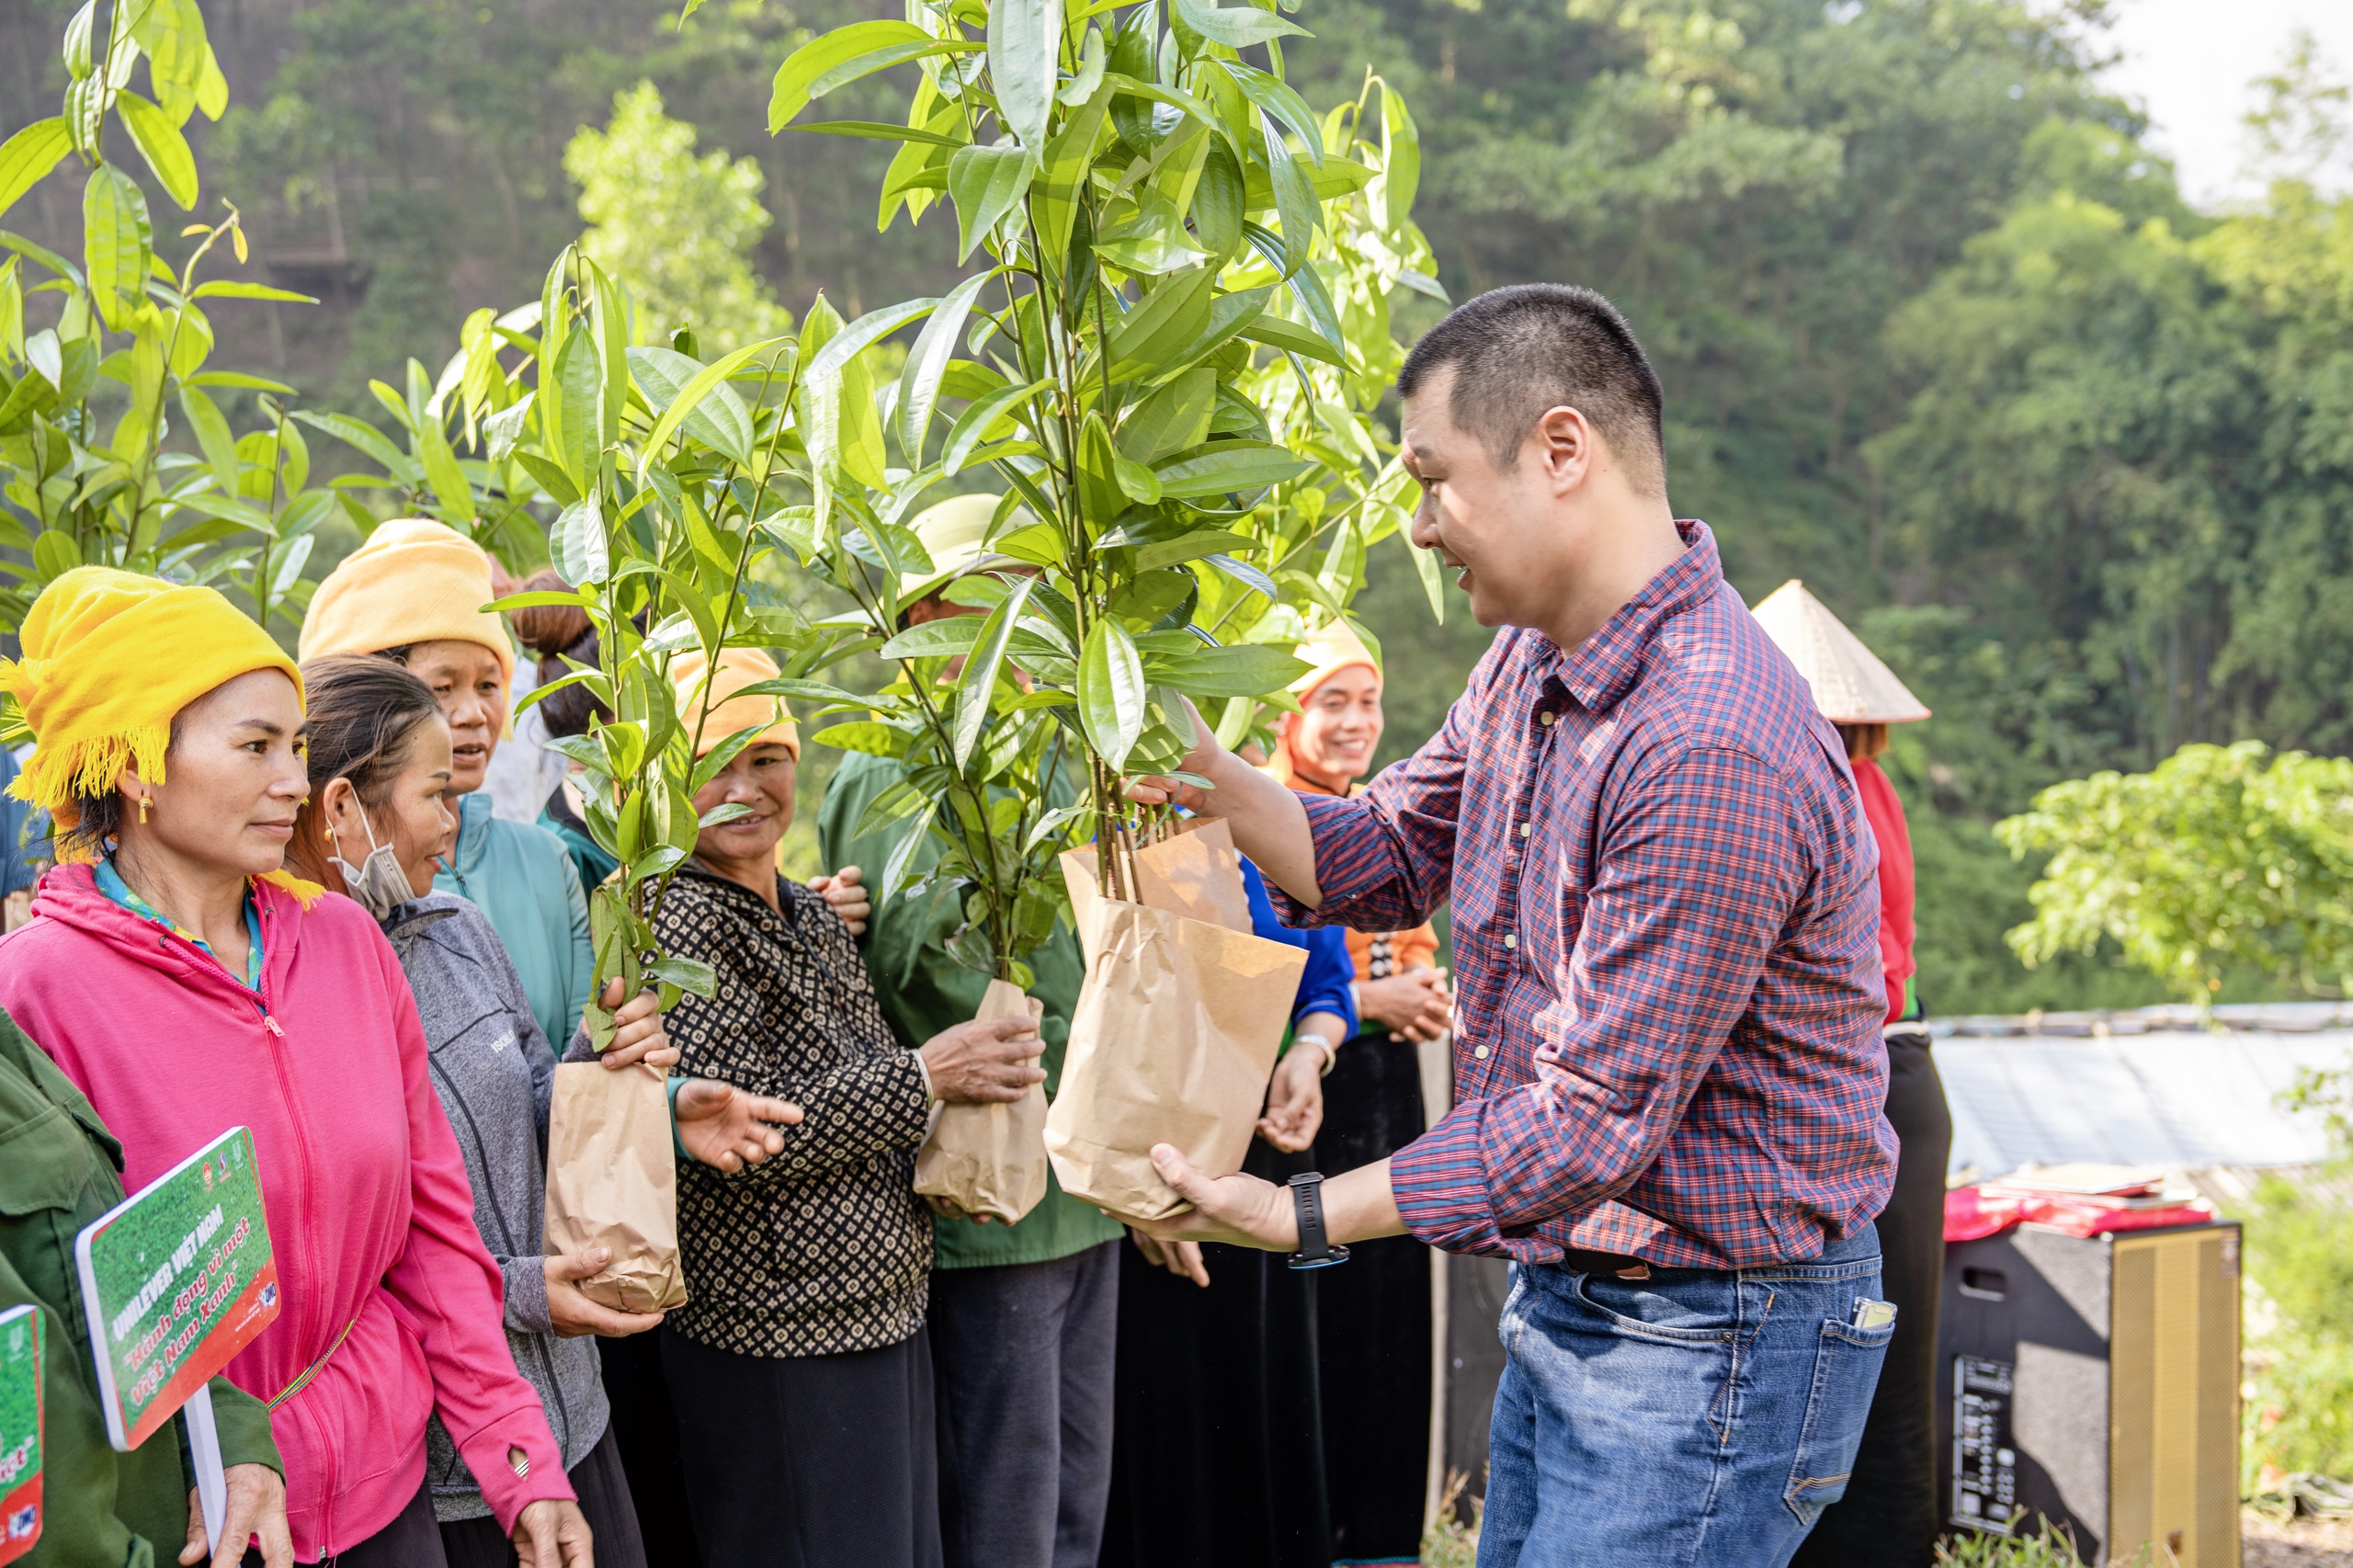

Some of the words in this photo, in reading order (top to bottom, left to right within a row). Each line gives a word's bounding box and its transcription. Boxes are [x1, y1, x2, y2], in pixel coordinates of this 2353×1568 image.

[112, 1261, 175, 1341] UNILEVER
[170, 1231, 199, 1275] VIỆT
[196, 1202, 224, 1248] NAM
[173, 1269, 209, 1321] động
[208, 1248, 222, 1276] vì
[222, 1216, 251, 1259] một
[265, 1282, 277, 1303] OMO
[131, 1358, 165, 1406] Việt
[164, 1317, 200, 1368] Nam
